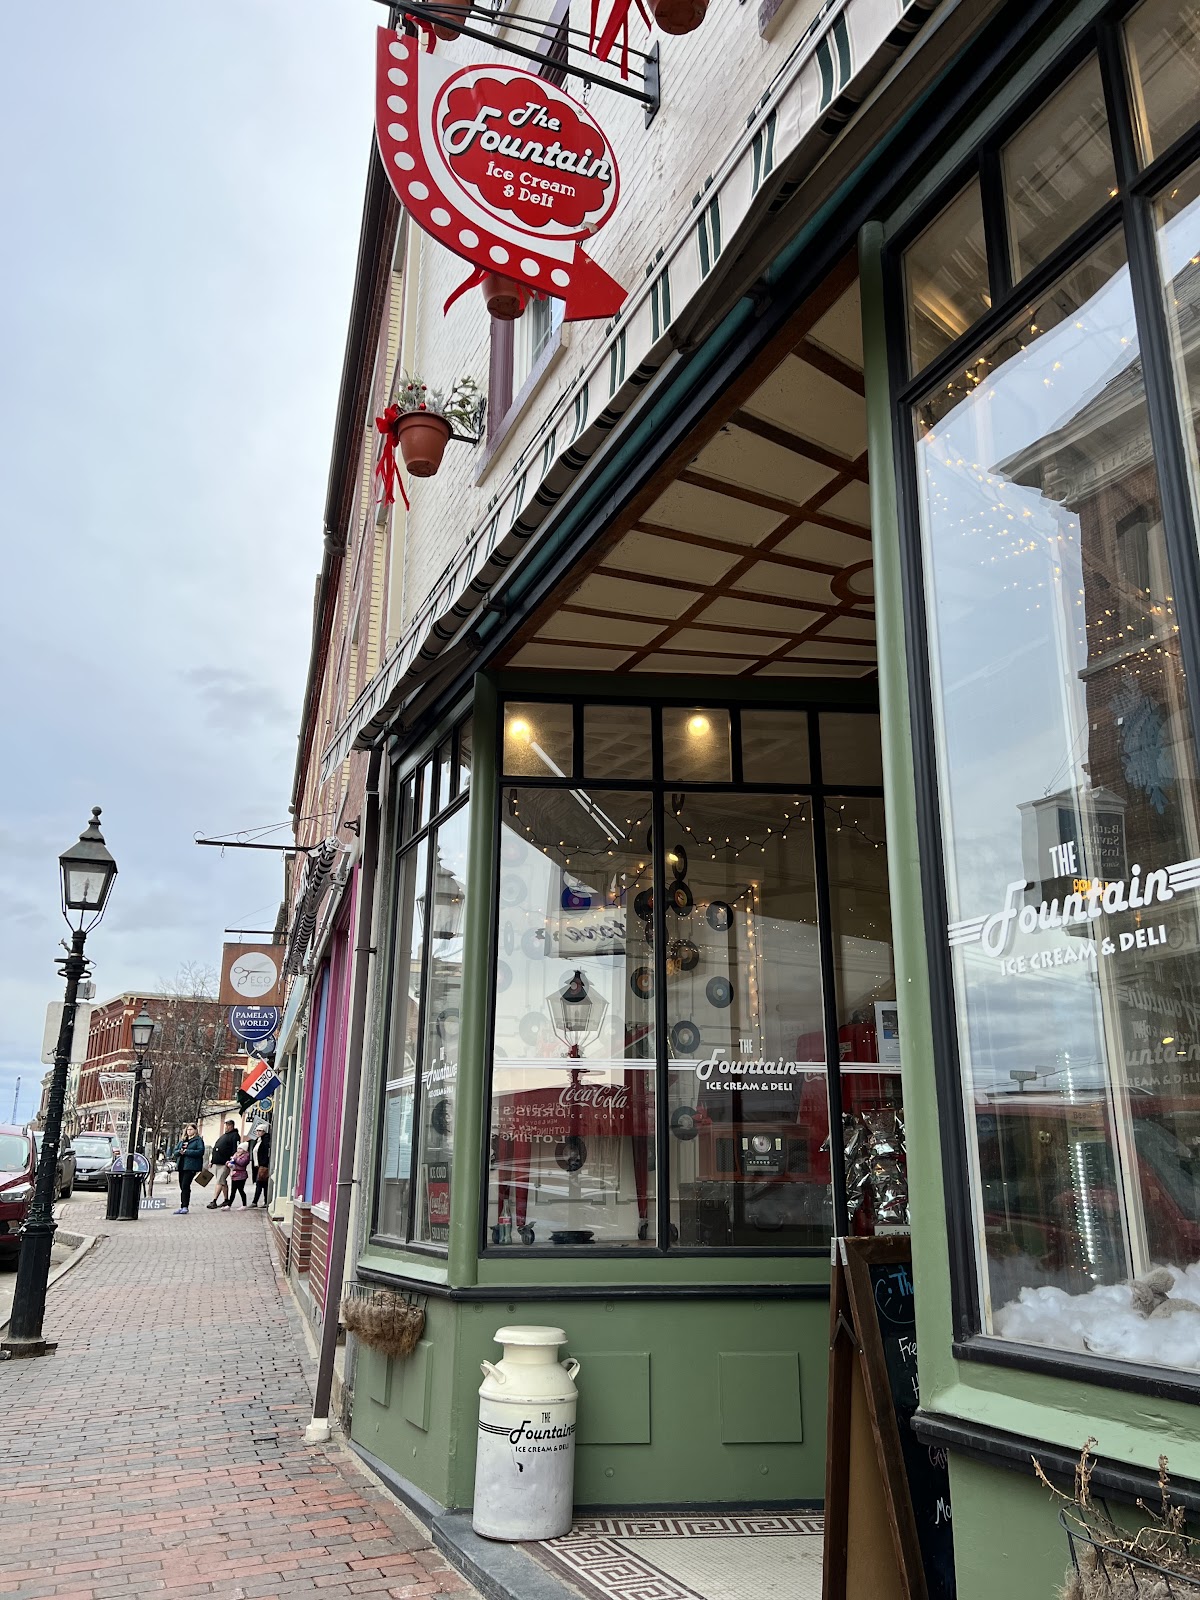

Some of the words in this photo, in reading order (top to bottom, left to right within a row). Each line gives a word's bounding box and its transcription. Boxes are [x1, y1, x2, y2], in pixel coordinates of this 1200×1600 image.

[507, 101, 561, 132] The
[443, 105, 612, 182] Fountain
[485, 160, 514, 180] Ice
[519, 171, 576, 197] Cream
[518, 187, 555, 208] Deli
[1049, 840, 1078, 879] THE
[981, 863, 1174, 958] Fountain
[999, 957, 1027, 976] ICE
[1030, 943, 1098, 970] CREAM
[1101, 936, 1116, 956] &
[1119, 924, 1167, 952] DELI
[250, 976, 272, 984] ECO
[235, 1011, 275, 1019] PAMELA'S
[238, 1019, 270, 1027] WORLD
[739, 1038, 753, 1054] THE
[1125, 1041, 1200, 1067] untain
[696, 1048, 798, 1081] Fountain
[706, 1081, 722, 1090] ICE
[723, 1081, 760, 1091] CREAM
[761, 1082, 769, 1091] &
[771, 1082, 793, 1091] DELI
[1128, 1076, 1161, 1088] REAM
[559, 1083, 630, 1109] Coca-Cola
[141, 1199, 161, 1209] OKS
[541, 1411, 551, 1423] THE
[509, 1420, 572, 1445] Fountain
[558, 1443, 570, 1451] DELI
